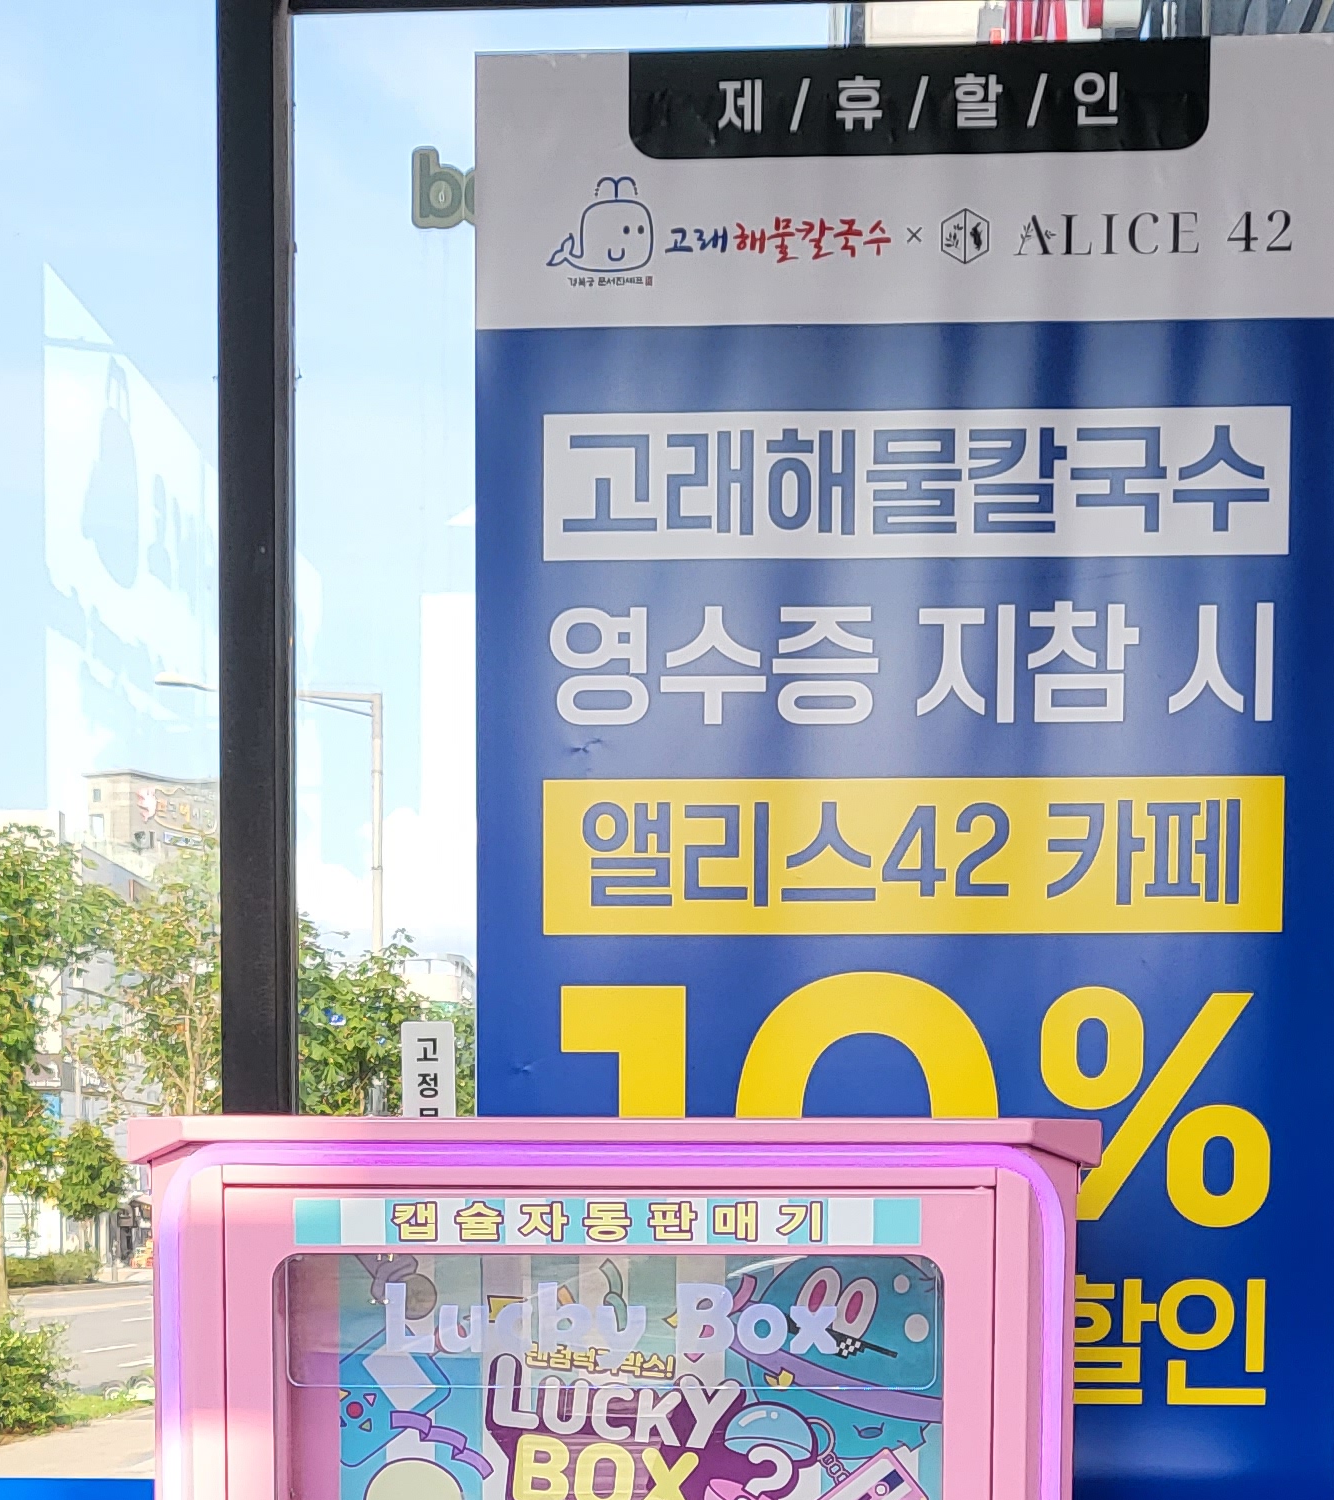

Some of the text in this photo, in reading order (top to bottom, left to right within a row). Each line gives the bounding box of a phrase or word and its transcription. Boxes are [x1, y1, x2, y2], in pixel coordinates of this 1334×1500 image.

[1017, 208, 1294, 257] ALICE 42
[561, 425, 1268, 538] 고래해물칼국수
[549, 601, 1274, 726] 영수증 지참 시
[581, 798, 1242, 909] 앨리스42 카페
[392, 1201, 825, 1242] 캡슐자동판매기
[675, 1282, 838, 1355] Box
[1074, 1274, 1267, 1407] 할인
[492, 1354, 743, 1447] LUCKY
